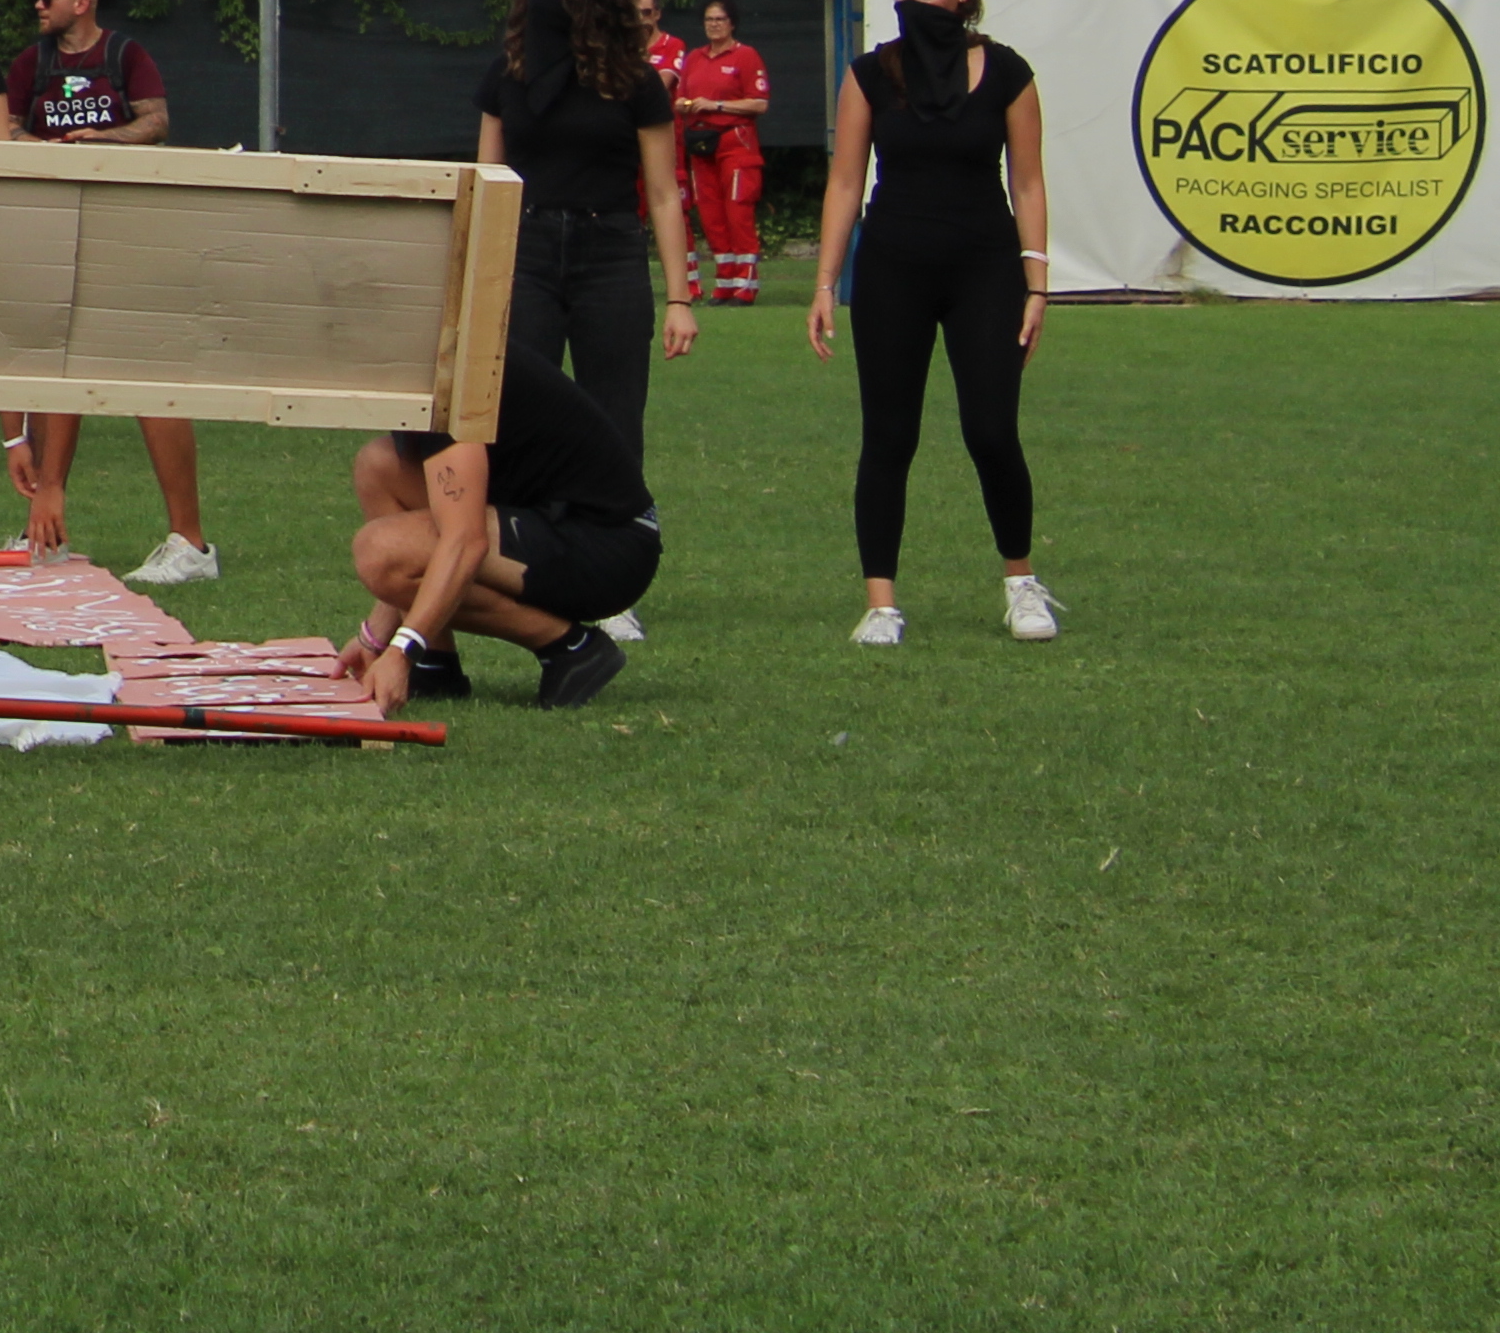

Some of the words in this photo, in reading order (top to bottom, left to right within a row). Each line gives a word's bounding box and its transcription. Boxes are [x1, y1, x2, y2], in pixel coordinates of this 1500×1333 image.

[1202, 53, 1423, 75] SCATOLIFICIO
[43, 95, 112, 113] BORGO
[46, 109, 112, 127] MACRA
[1175, 177, 1308, 199] PACKAGING
[1315, 178, 1444, 199] SPECIALIST
[1219, 213, 1398, 236] RACCONIGI
